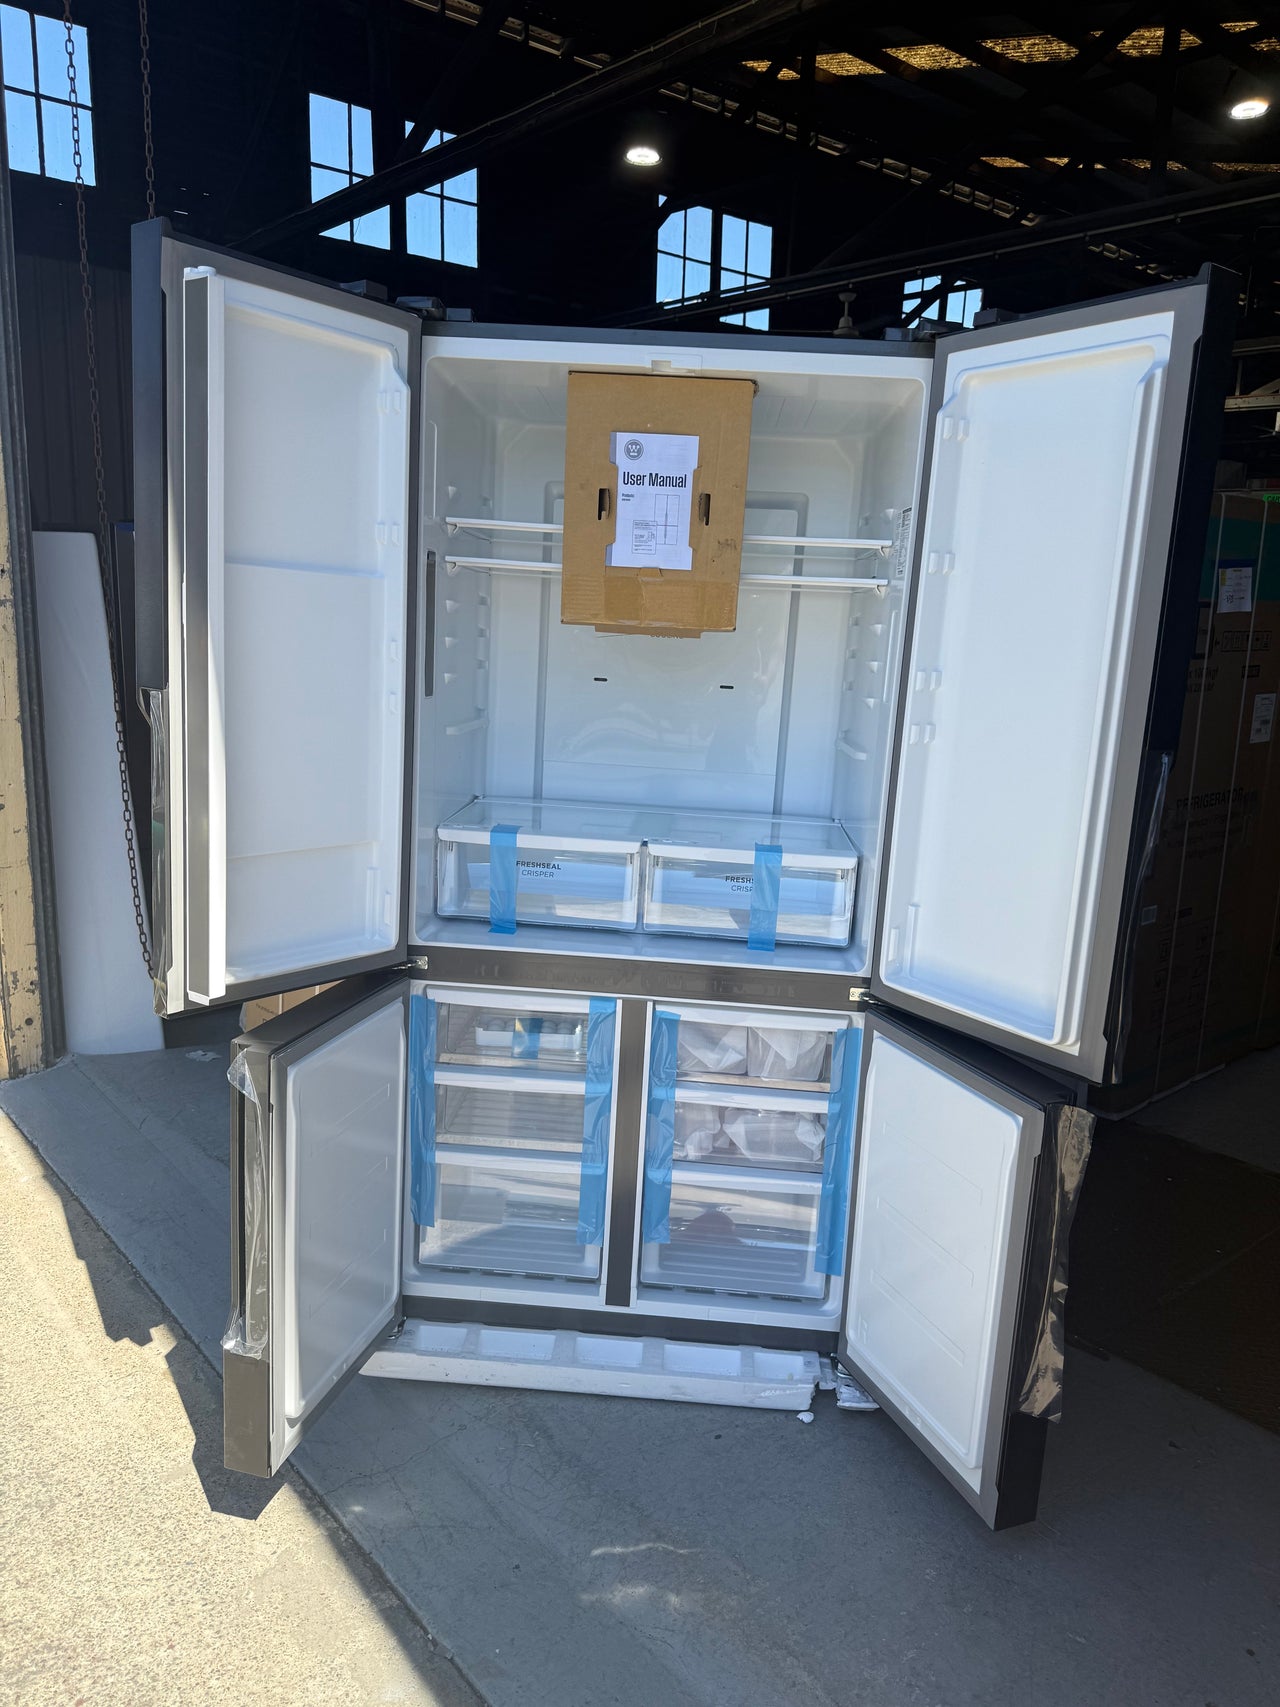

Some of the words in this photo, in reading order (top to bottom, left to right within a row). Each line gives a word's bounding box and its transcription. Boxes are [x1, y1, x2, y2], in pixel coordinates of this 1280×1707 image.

[622, 471, 647, 486] User
[648, 472, 687, 488] Manual
[516, 860, 562, 870] FRESHSEAL
[521, 869, 555, 878] CRISPER
[725, 875, 754, 884] FRESH
